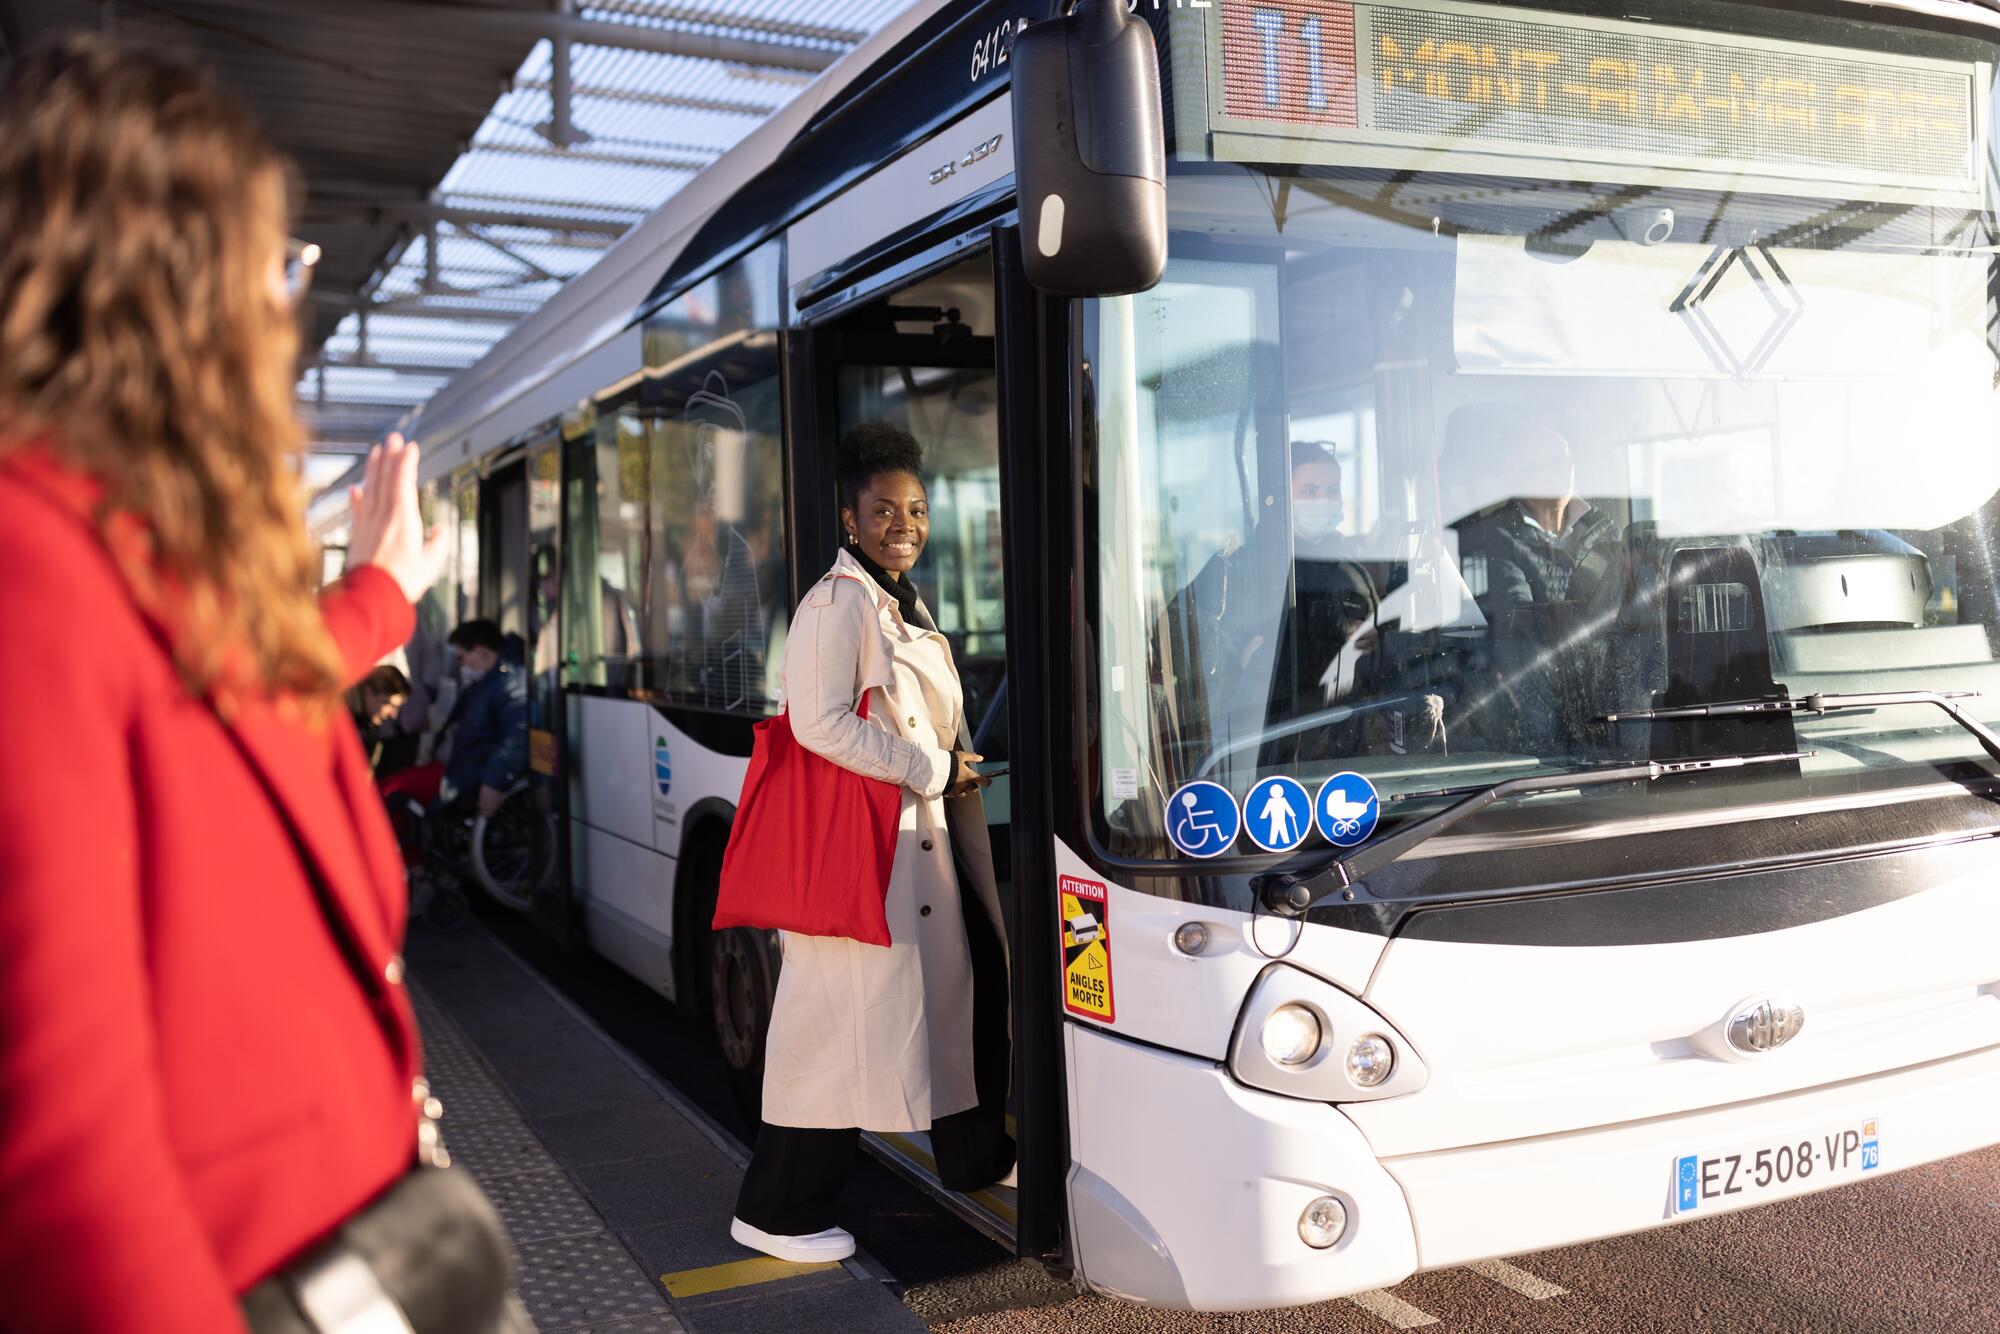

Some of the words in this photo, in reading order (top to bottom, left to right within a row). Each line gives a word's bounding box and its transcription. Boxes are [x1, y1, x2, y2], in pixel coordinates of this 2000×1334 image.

[1254, 11, 1328, 110] T1
[961, 134, 1003, 167] 437
[1062, 879, 1104, 899] ATTENTION
[1070, 972, 1105, 993] ANGLES
[1072, 988, 1104, 1008] MORTS
[1702, 1130, 1860, 1199] EZ-508-VP
[1863, 1145, 1878, 1168] 76
[1684, 1188, 1692, 1202] F
